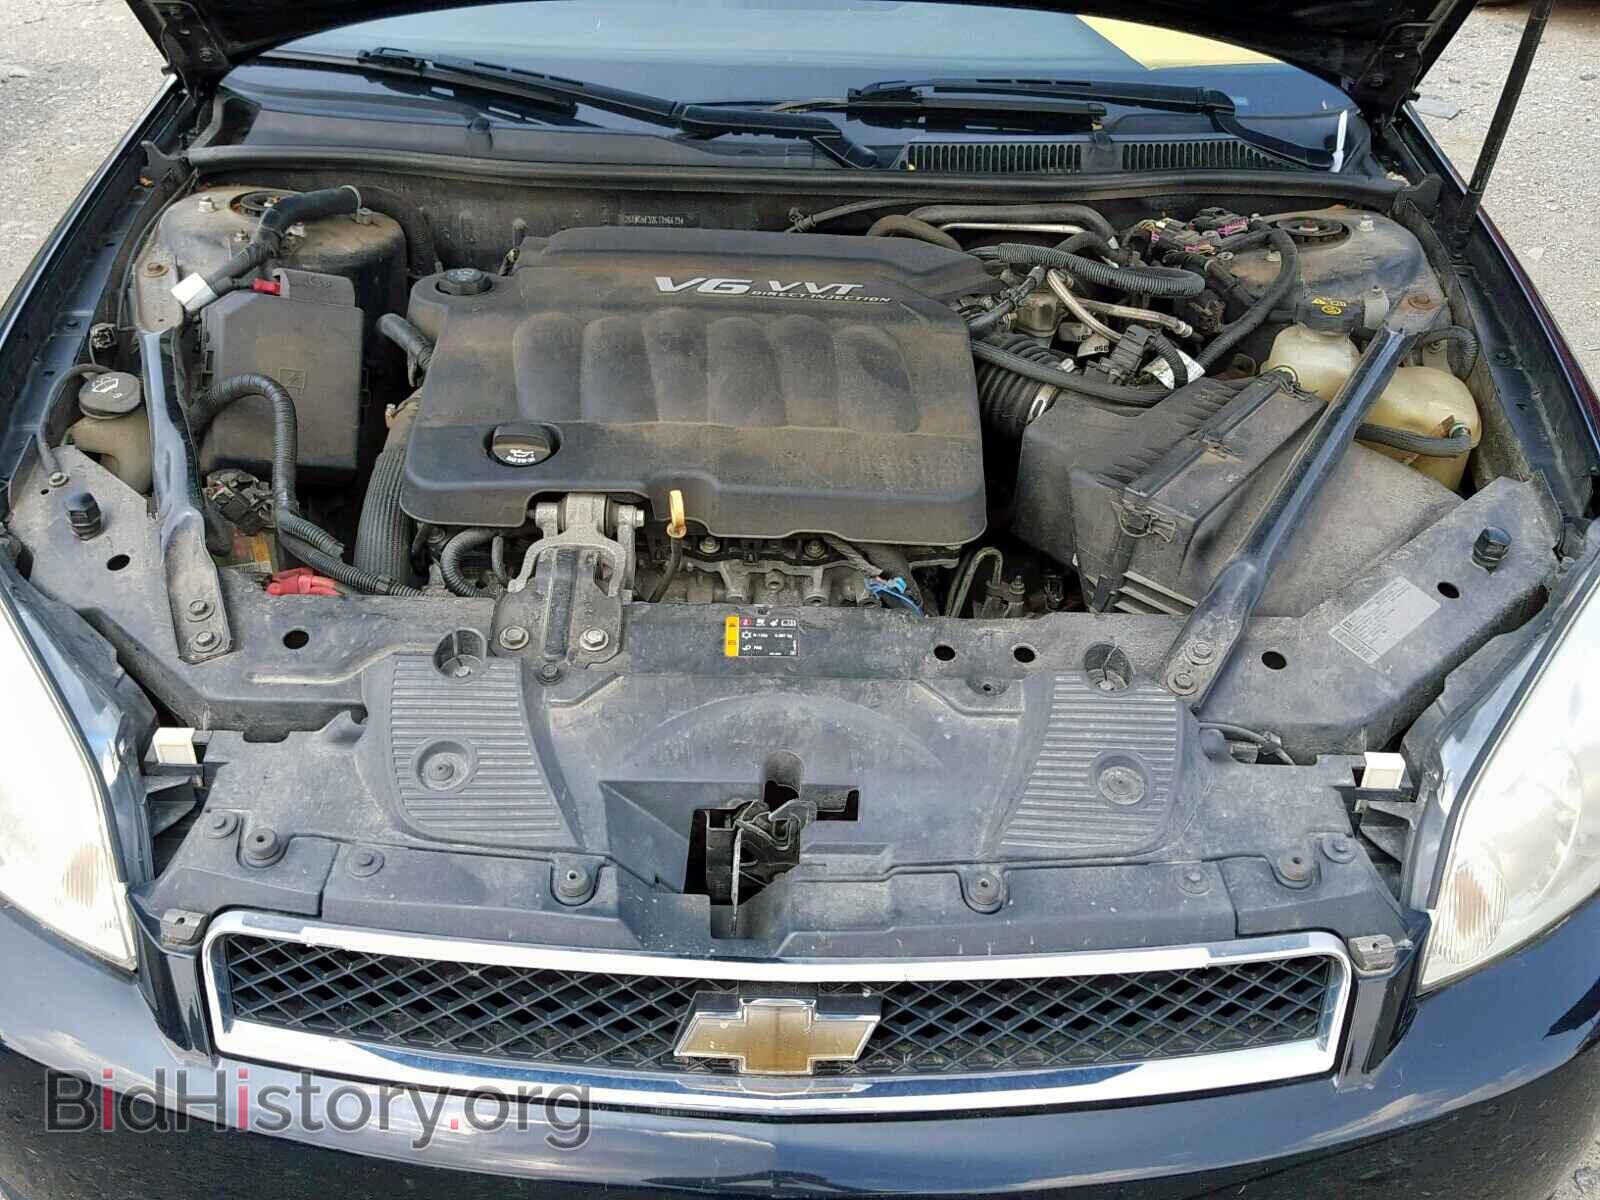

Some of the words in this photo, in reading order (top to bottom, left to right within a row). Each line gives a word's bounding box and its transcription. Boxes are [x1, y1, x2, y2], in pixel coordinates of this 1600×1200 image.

[655, 277, 753, 294] V6
[768, 280, 864, 295] VVT
[752, 290, 807, 298] DIRECT
[809, 294, 891, 303] INJECTION
